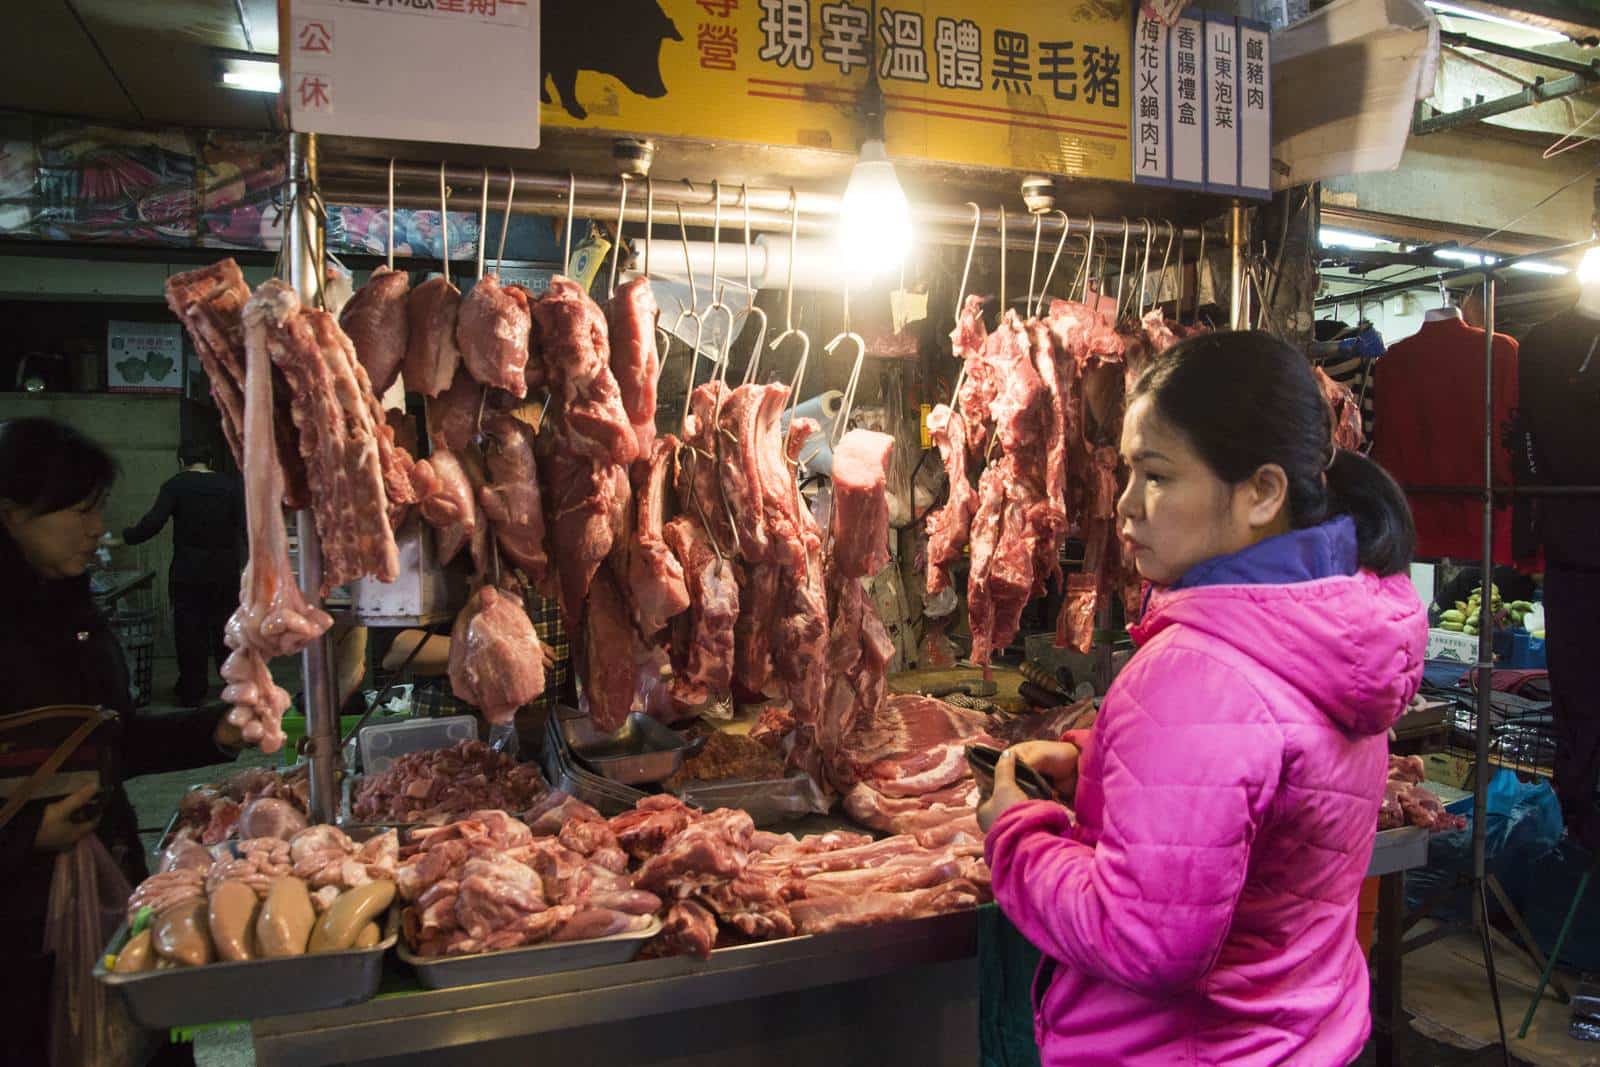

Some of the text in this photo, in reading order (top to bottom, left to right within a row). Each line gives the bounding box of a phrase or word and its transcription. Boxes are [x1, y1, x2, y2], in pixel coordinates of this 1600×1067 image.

[1139, 18, 1160, 171] 梅花火鍋肉片
[1177, 26, 1197, 126] 香腸禮盒
[1214, 31, 1233, 129] 山東泡菜
